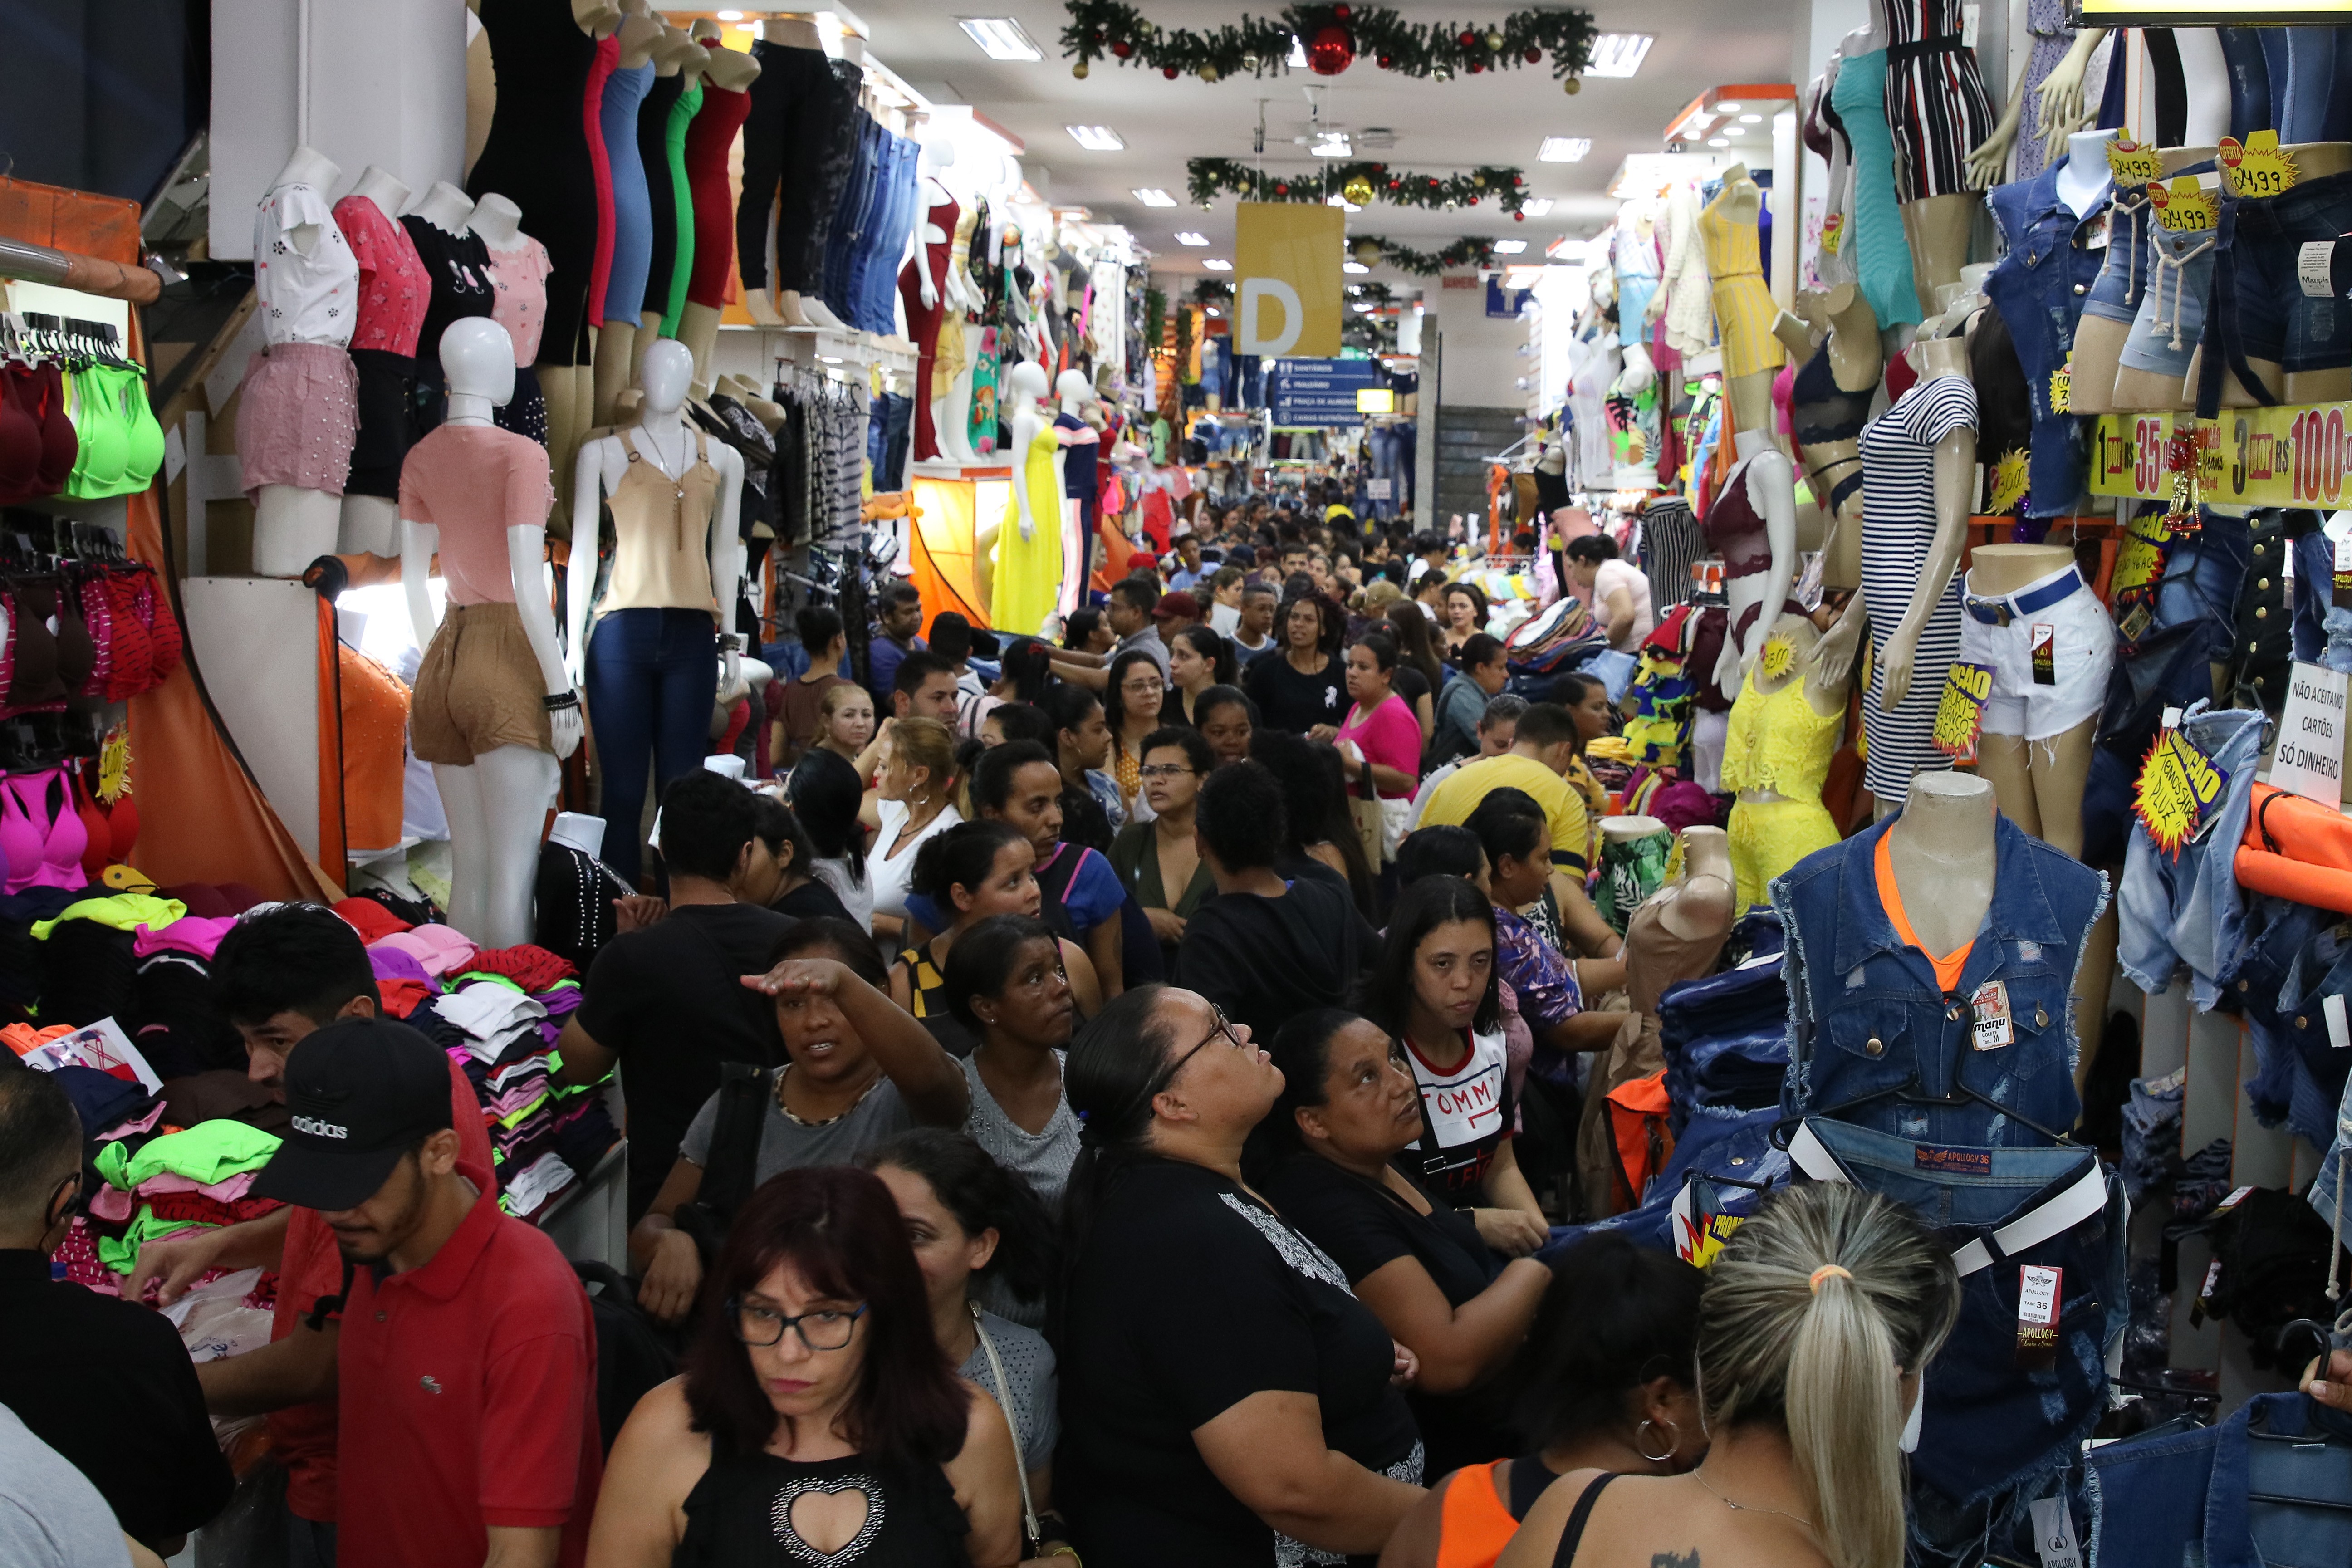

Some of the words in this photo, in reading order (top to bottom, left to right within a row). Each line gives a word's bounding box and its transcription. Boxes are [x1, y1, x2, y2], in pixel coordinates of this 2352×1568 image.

[2220, 145, 2242, 160] OFERTA
[2115, 159, 2151, 179] 24,99
[2234, 167, 2280, 192] 24,99
[2148, 189, 2168, 202] OFERTA
[2163, 208, 2206, 230] 24,99
[1240, 278, 1303, 356] D
[2098, 426, 2105, 485] 1
[2124, 441, 2134, 471] R$
[2135, 419, 2171, 494] 35,0
[2233, 418, 2247, 495] 3
[2249, 437, 2273, 477] por
[2275, 437, 2289, 476] R$
[2293, 680, 2310, 700] NÃO
[2311, 687, 2344, 710] ACEITAMOS
[2302, 716, 2333, 739] CARTÕES
[2171, 729, 2221, 804] PROMOÇÃO
[2279, 741, 2295, 764] SÓ
[2297, 749, 2338, 779] DINHEIRO
[1974, 1018, 2006, 1033] manu
[1994, 1034, 1999, 1043] M
[1423, 1077, 1494, 1114] OMM
[291, 1115, 348, 1139] adidas
[1948, 1152, 1979, 1163] APOLLOGY
[1980, 1154, 1989, 1165] 36
[2036, 1301, 2048, 1310] 36
[2047, 1557, 2077, 1568] APOLLOGY
